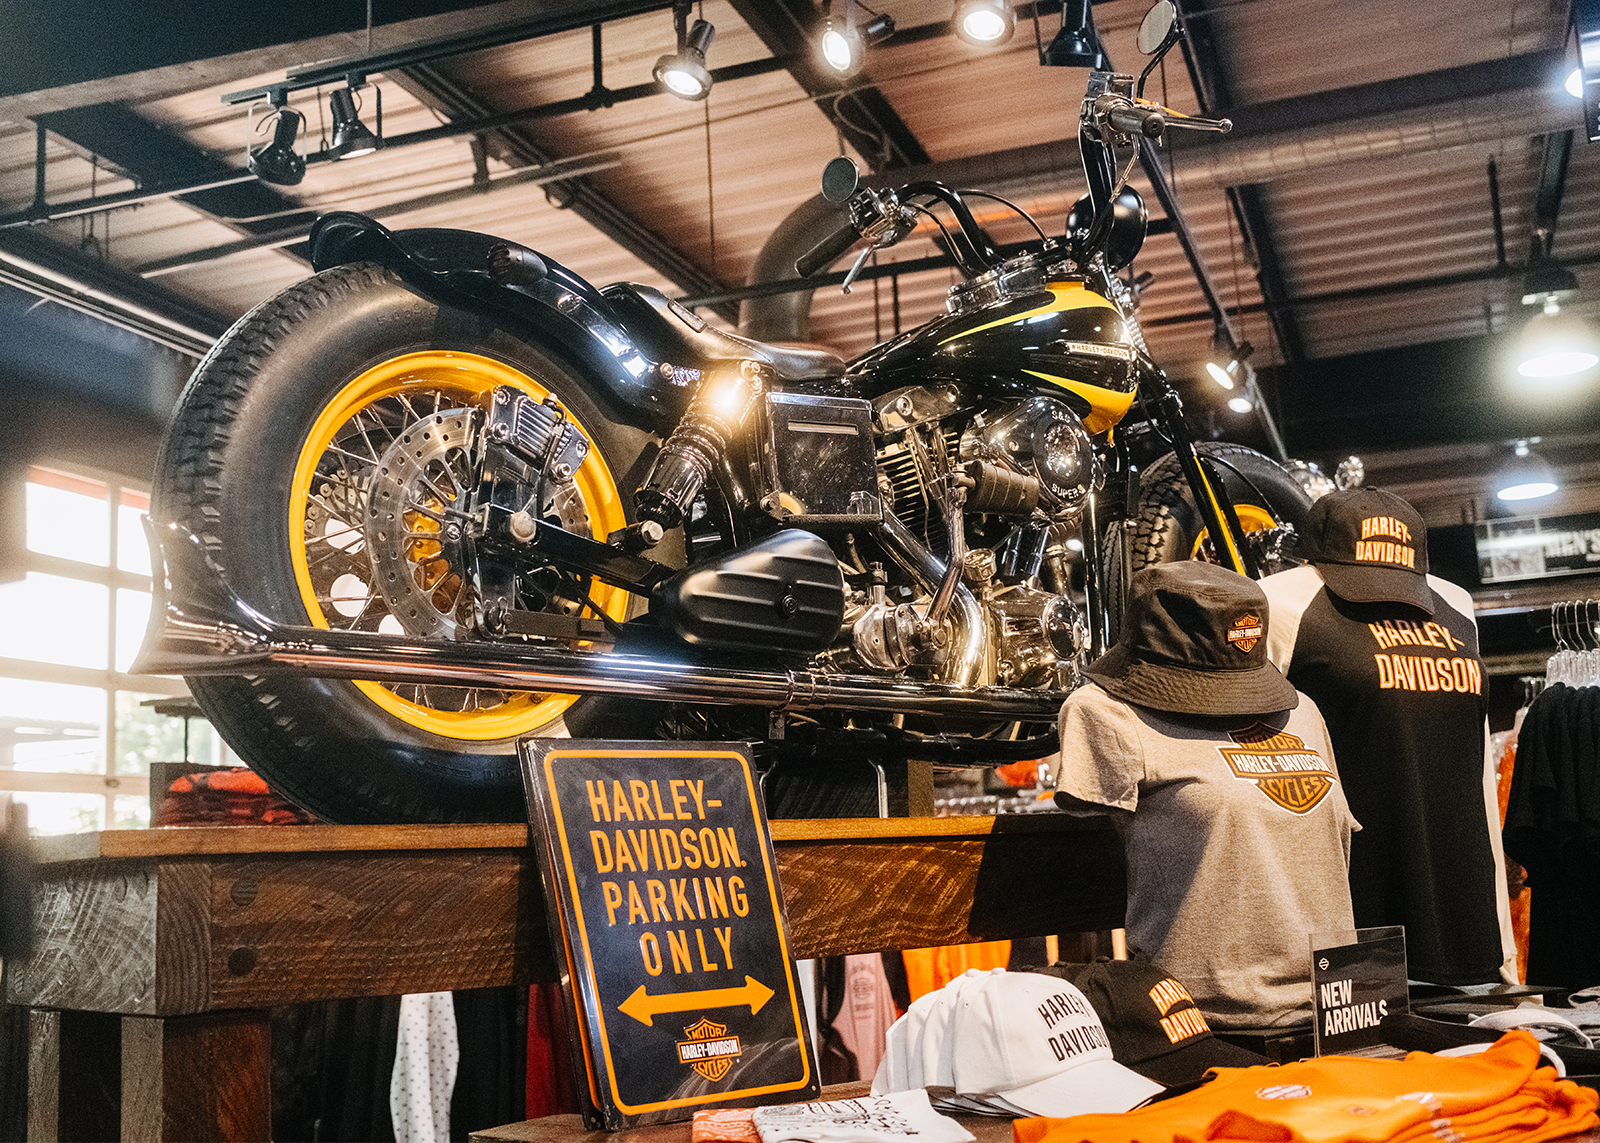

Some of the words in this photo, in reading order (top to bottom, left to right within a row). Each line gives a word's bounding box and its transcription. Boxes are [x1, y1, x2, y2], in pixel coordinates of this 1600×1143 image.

[1076, 344, 1128, 357] HARLEY-DAVIDSON
[1361, 516, 1412, 543] HARLEY-
[1355, 541, 1415, 569] DAVIDSON
[1368, 619, 1466, 651] HARLEY-
[1374, 653, 1482, 695] DAVIDSON
[585, 779, 723, 822] HARLEY-
[1266, 776, 1322, 806] CYCLES
[602, 875, 750, 927] PARKING
[639, 926, 734, 977] ONLY
[1320, 979, 1353, 1010] NEW
[691, 1023, 722, 1040] MOTOR
[1324, 999, 1388, 1037] ARRIVALS
[680, 1038, 739, 1060] HARLEY-DAVIDSON
[697, 1058, 729, 1078] CYCLES
